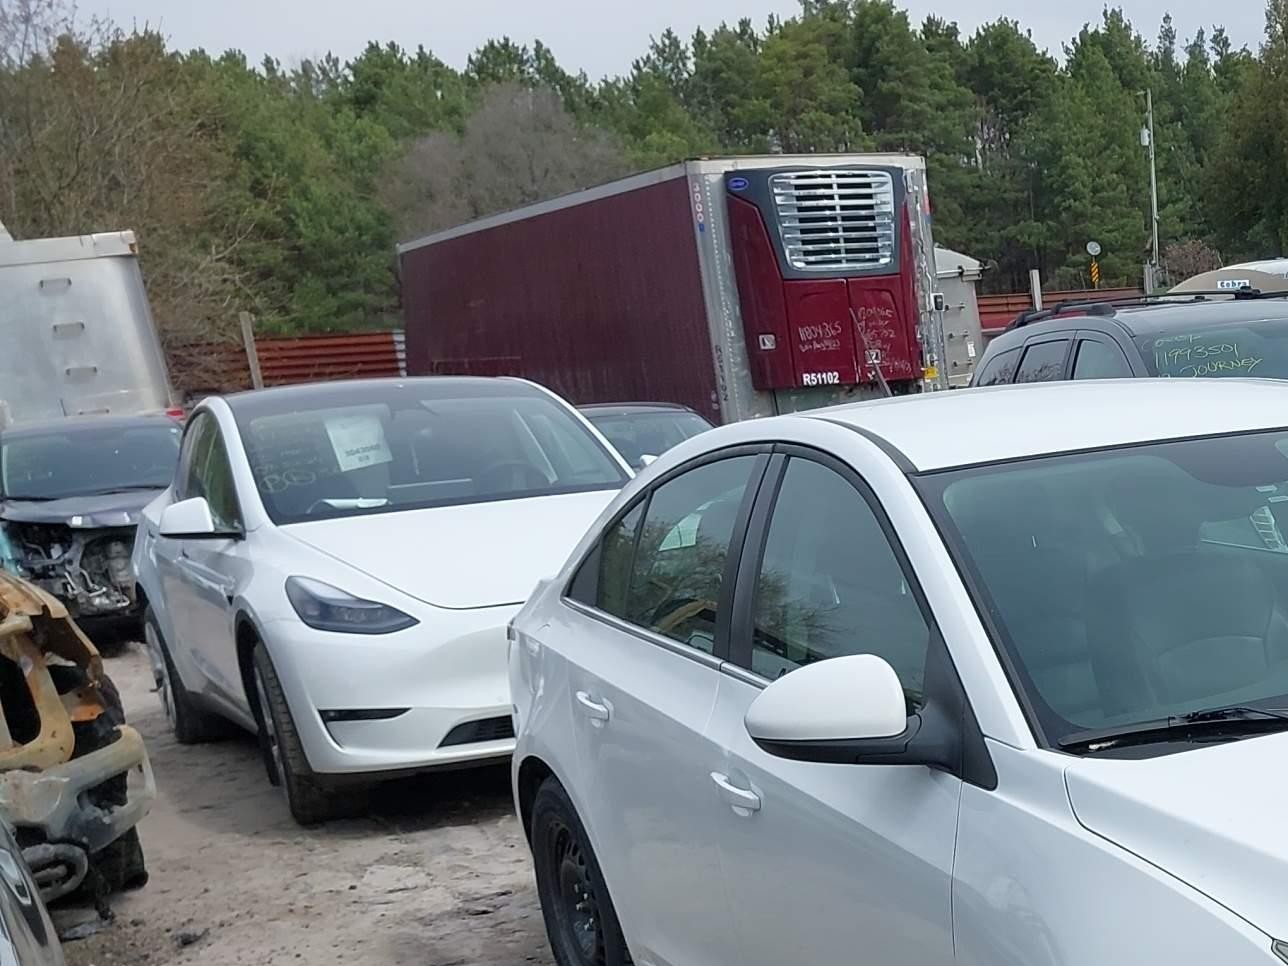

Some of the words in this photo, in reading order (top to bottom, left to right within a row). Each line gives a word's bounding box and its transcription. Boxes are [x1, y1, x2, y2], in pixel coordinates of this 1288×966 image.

[1154, 343, 1239, 368] 11993501
[1179, 357, 1264, 378] JOURNEY
[802, 371, 840, 386] R51102
